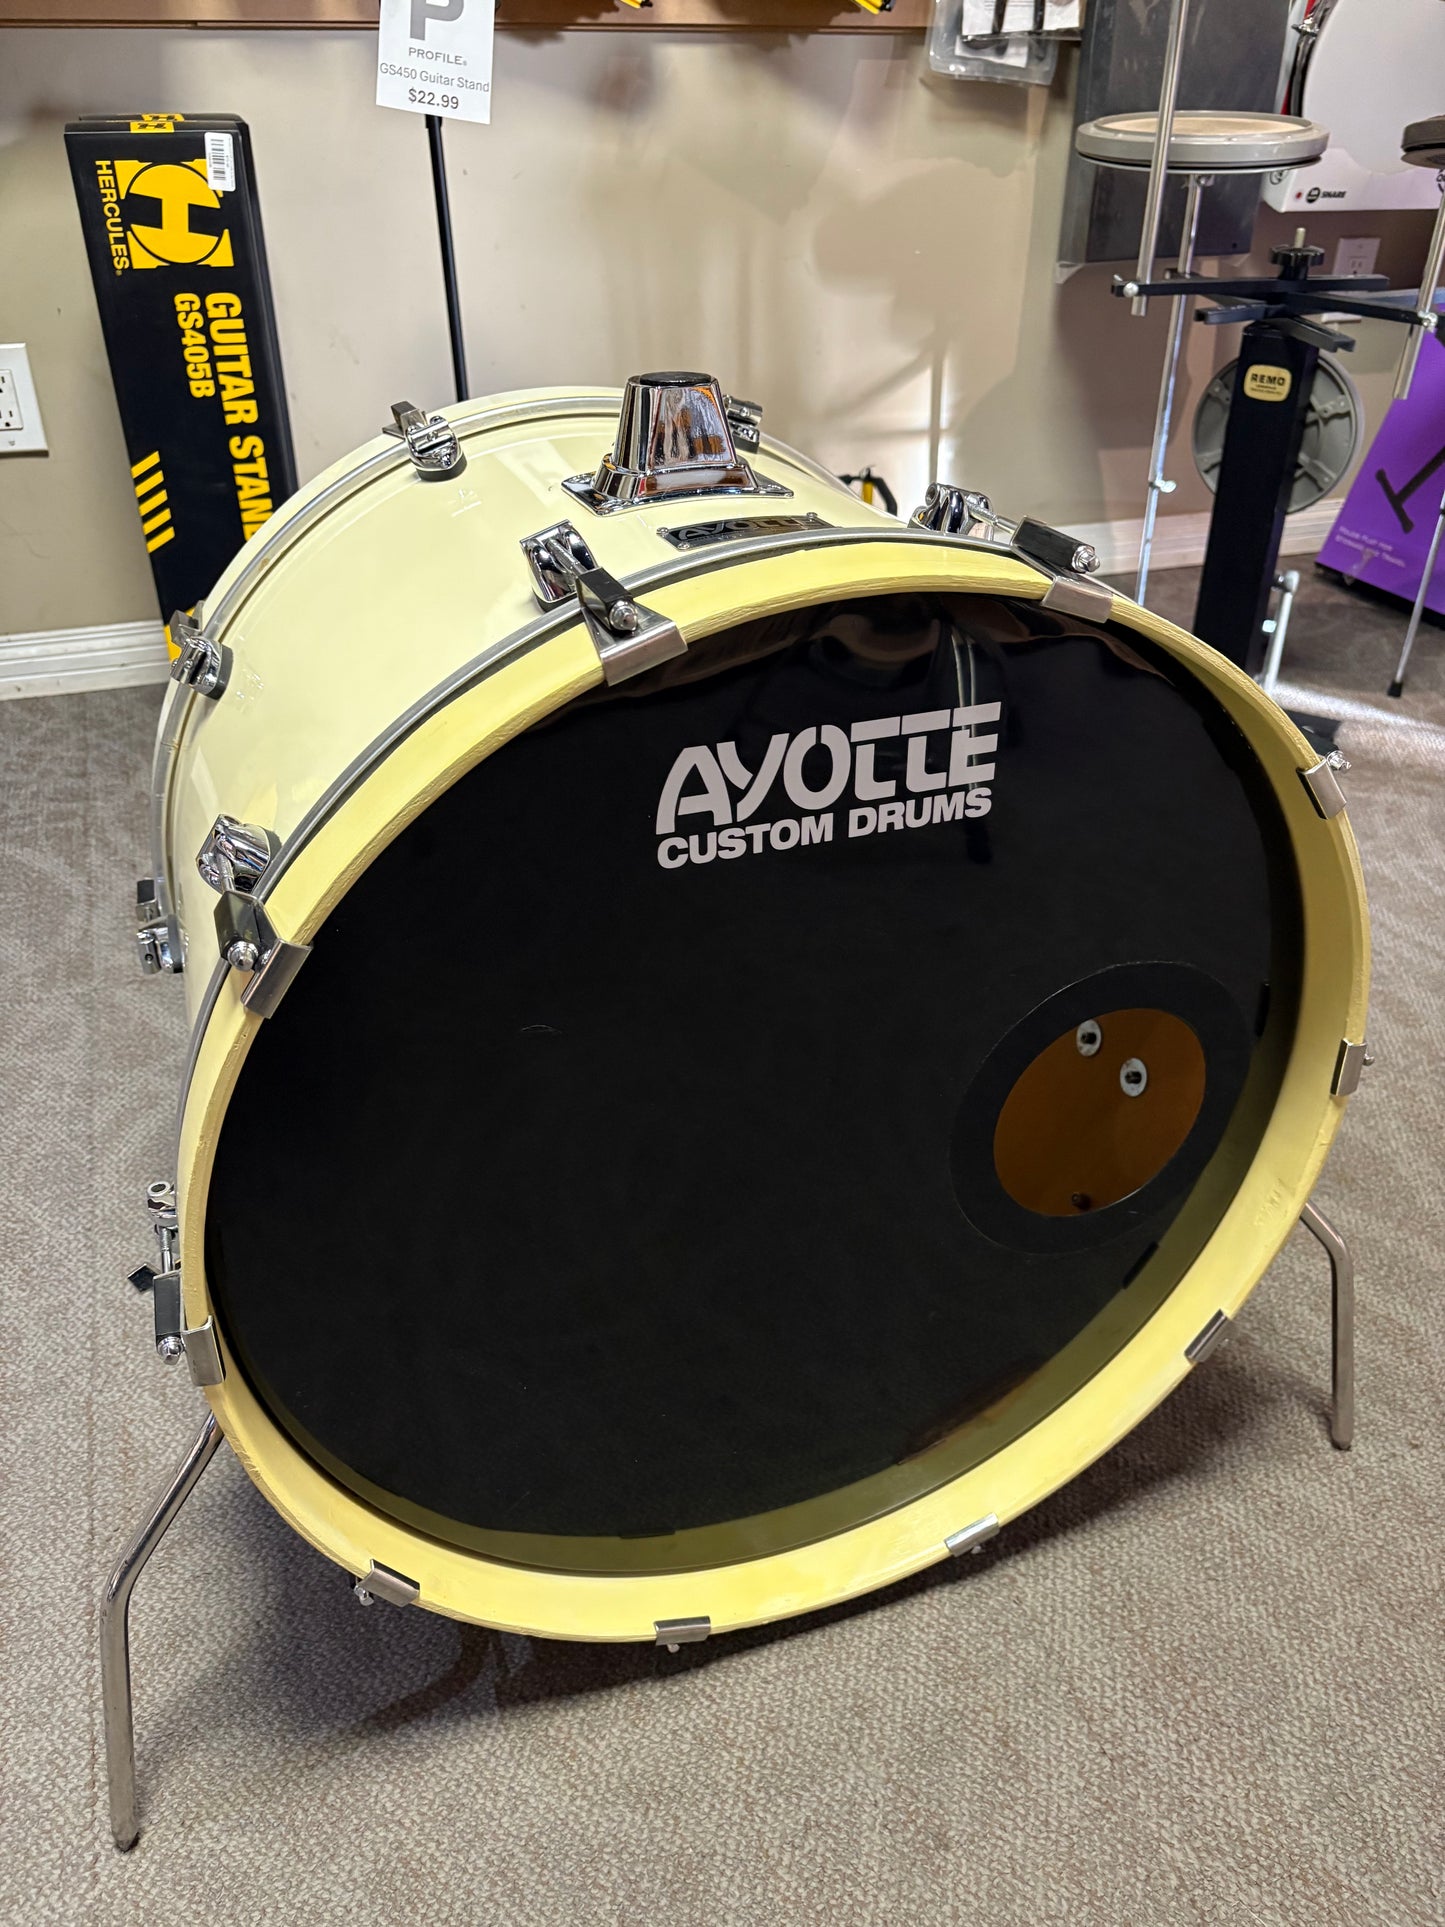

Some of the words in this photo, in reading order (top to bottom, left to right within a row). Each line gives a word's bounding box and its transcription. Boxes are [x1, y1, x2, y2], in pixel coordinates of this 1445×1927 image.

[380, 62, 417, 79] GS450
[420, 70, 455, 86] Guitar
[457, 77, 490, 92] Stand
[408, 87, 459, 109] $22.99
[95, 160, 129, 270] HERCULES
[173, 292, 216, 398] GS405B
[205, 292, 259, 426] GUITAR
[1251, 373, 1286, 386] REMO
[656, 701, 1002, 835] AYOTTE
[657, 813, 834, 869] CUSTOM
[848, 787, 993, 838] DRUMS
